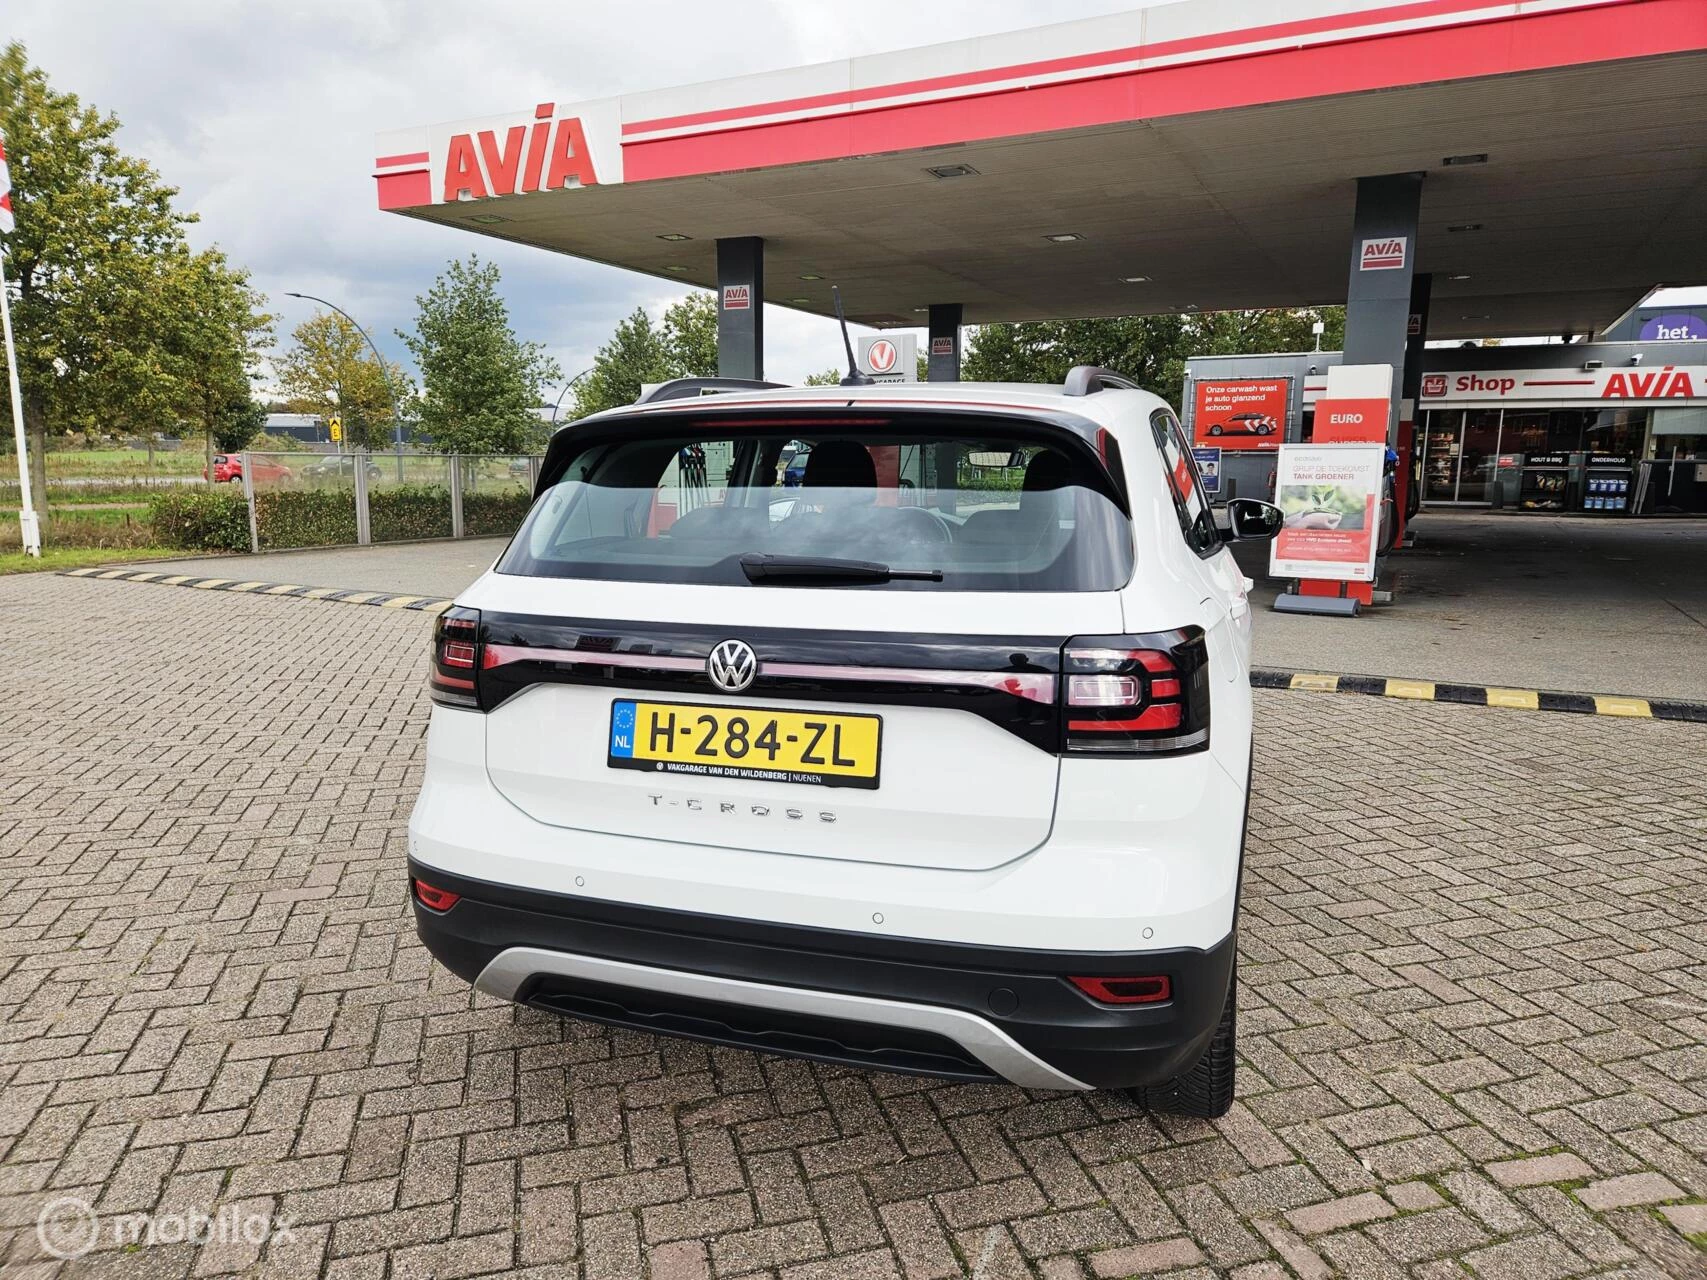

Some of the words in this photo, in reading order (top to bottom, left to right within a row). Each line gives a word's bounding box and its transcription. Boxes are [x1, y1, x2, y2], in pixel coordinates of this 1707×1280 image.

[443, 102, 599, 202] AVIA
[1364, 239, 1403, 256] AVIA
[725, 286, 749, 299] AVIA
[1227, 385, 1258, 393] carwash
[1259, 384, 1278, 392] wast
[1456, 374, 1515, 395] Shop
[1601, 365, 1695, 398] AVIA
[1232, 394, 1266, 403] glanzend
[1330, 413, 1364, 424] EURO
[615, 735, 631, 749] NL
[649, 711, 856, 767] H-284-ZL
[667, 763, 707, 774] VAKGARAGE
[708, 766, 723, 776] VAN
[724, 768, 739, 777] DEN
[740, 769, 787, 781] WILDENBERG
[793, 774, 822, 784] NUENEN
[648, 794, 837, 824] T-CROSS
